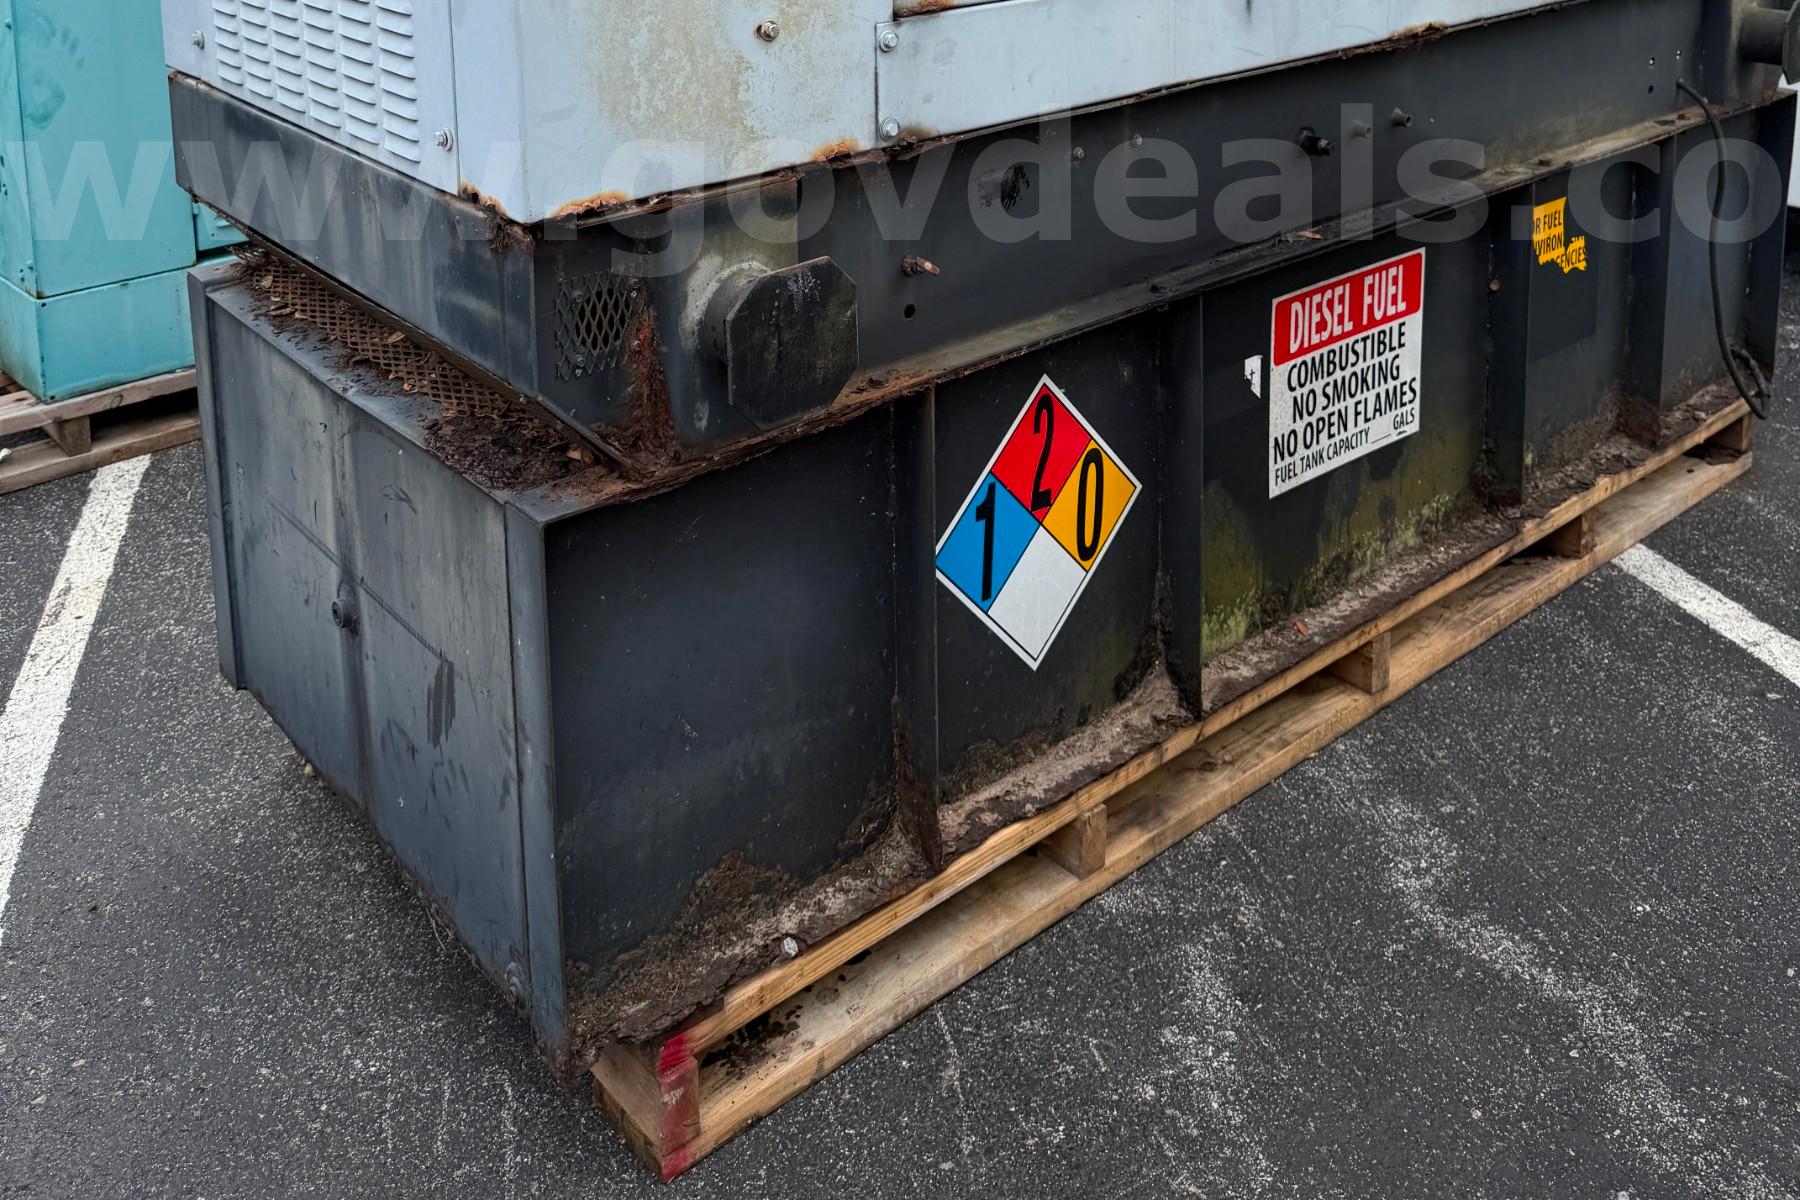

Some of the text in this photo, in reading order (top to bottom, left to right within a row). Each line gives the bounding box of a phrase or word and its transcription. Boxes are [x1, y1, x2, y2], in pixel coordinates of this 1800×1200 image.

[1543, 210, 1562, 232] FUEL
[1289, 264, 1407, 354] DIESEL FUEL
[1287, 321, 1406, 393] COMBUSTIBLE
[1292, 354, 1400, 424] NO SMOKING
[1031, 394, 1054, 512] 2
[1273, 377, 1417, 464] NO OPEN FLAMES
[1274, 407, 1415, 486] FUEL TANK CAPACITY GALS
[975, 481, 996, 601] 1
[1077, 448, 1104, 561] 0
